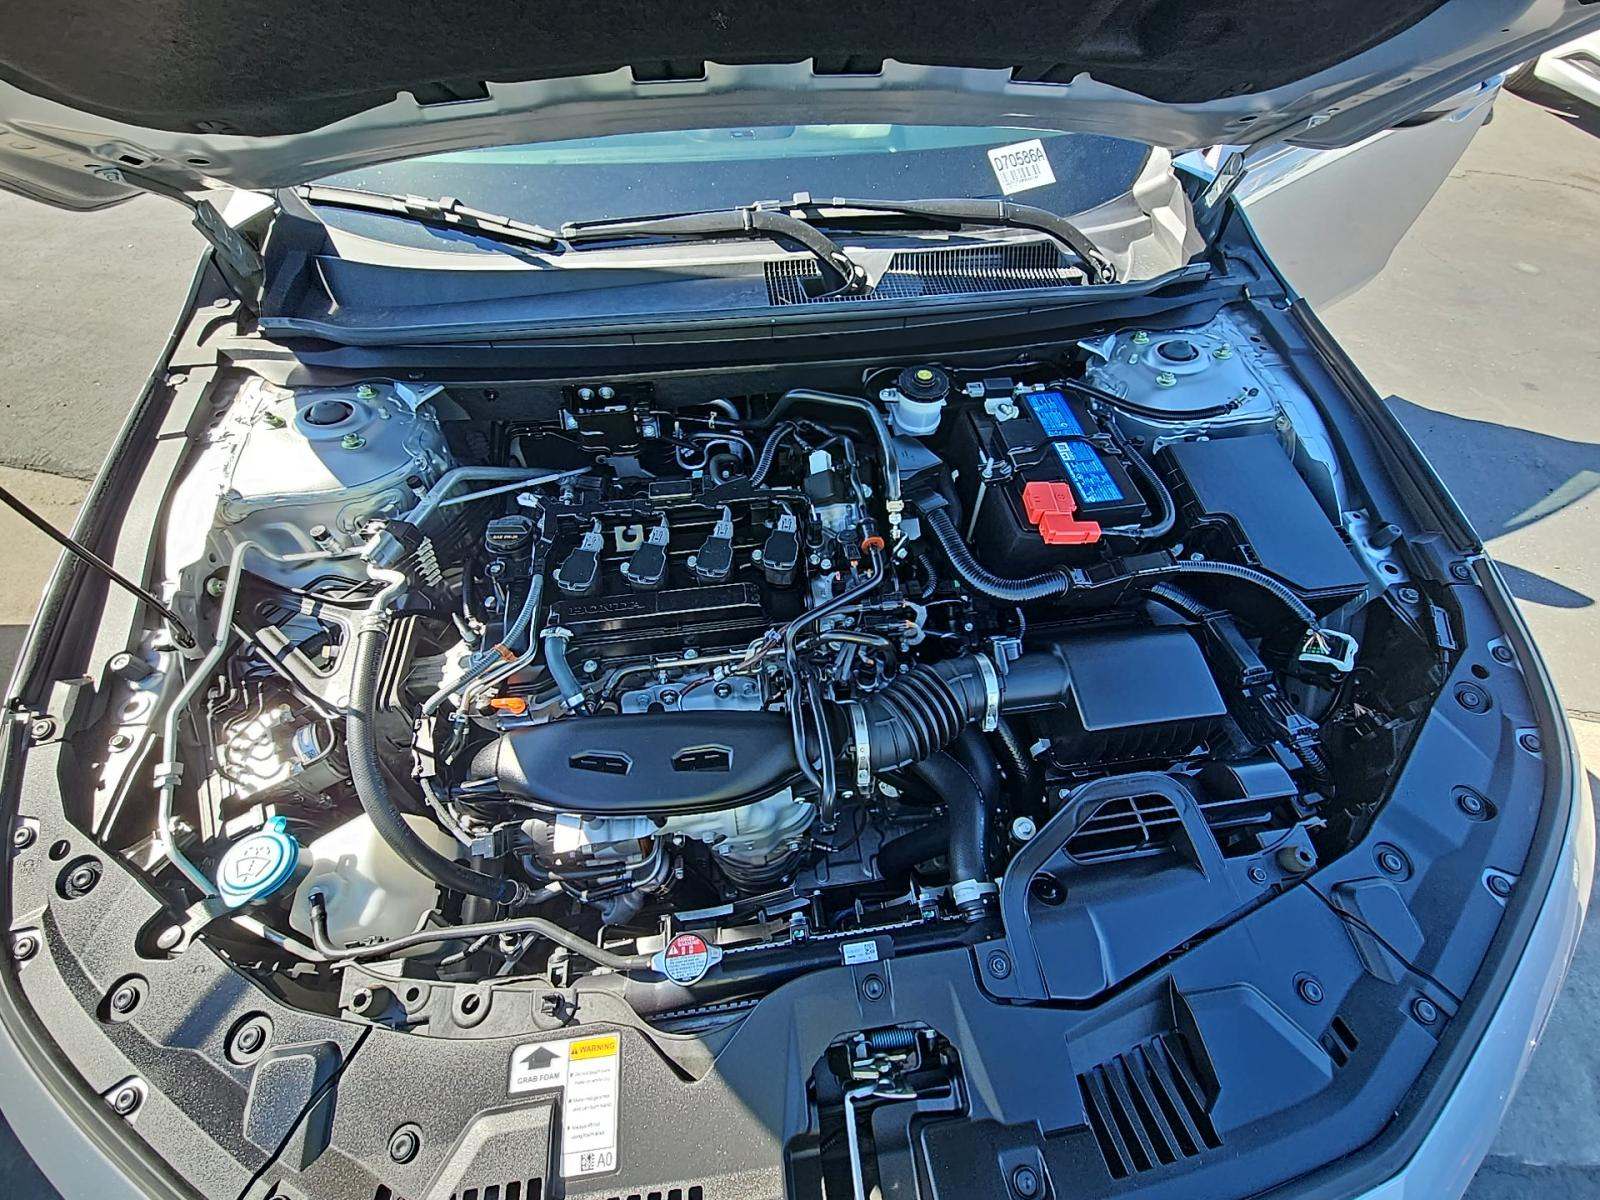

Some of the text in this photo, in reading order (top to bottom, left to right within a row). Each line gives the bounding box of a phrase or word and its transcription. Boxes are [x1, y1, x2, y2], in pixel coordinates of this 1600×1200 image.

[994, 147, 1045, 171] D70586A
[580, 1043, 615, 1054] WARNING
[517, 1072, 560, 1085] GRAB FOAM
